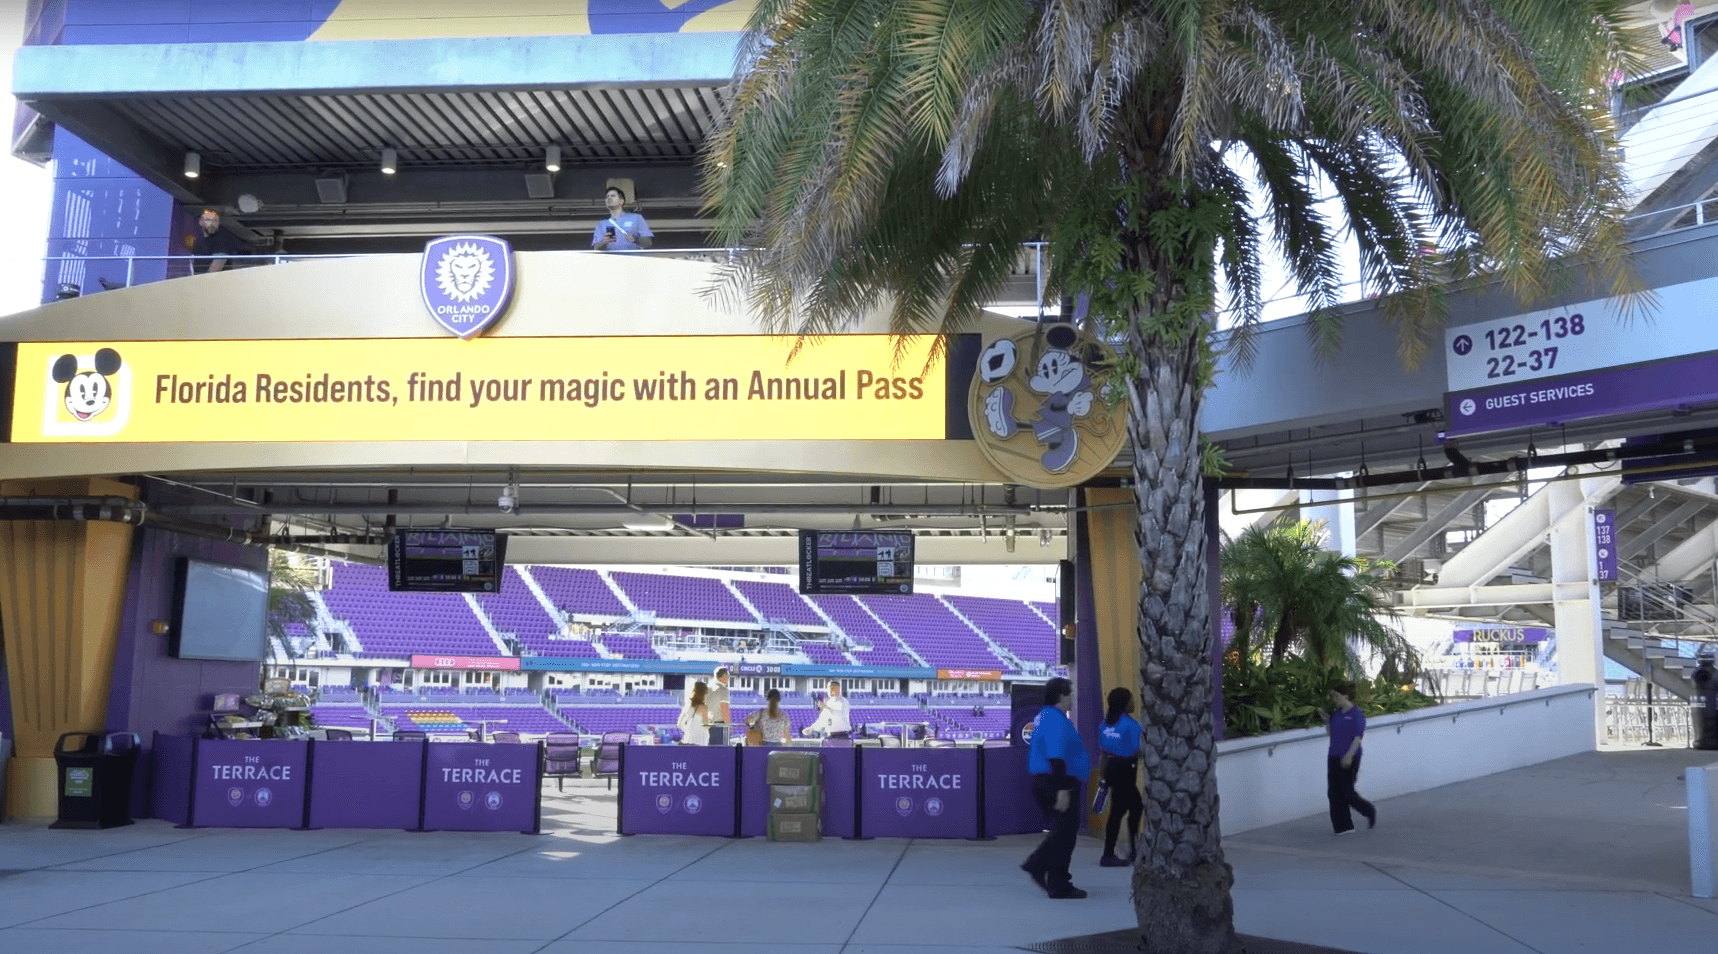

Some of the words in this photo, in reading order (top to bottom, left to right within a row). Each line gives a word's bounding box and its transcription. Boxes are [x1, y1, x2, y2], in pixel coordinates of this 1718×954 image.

[437, 305, 490, 315] ORLANDO
[451, 314, 475, 324] CITY
[1485, 314, 1585, 350] 122-138
[1486, 346, 1558, 379] 22-37
[155, 374, 247, 404] Florida
[255, 373, 398, 407] Residents,
[407, 371, 461, 402] find
[469, 378, 532, 408] your
[540, 371, 625, 408] magic
[633, 370, 696, 401] with
[704, 377, 738, 401] an
[747, 369, 846, 401] Annual
[856, 369, 924, 400] Pass
[1485, 393, 1526, 410] GUEST
[1530, 383, 1594, 404] SERVICES
[1597, 525, 1610, 535] 137
[1597, 534, 1611, 544] 138
[1599, 561, 1603, 570] 1
[1599, 570, 1609, 579] 37
[1473, 628, 1525, 642] RUCKUS
[212, 765, 291, 780] TERRACE
[911, 764, 927, 772] THE
[442, 768, 521, 783] TERRACE
[639, 772, 720, 787] TERRACE
[878, 774, 961, 789] TERRACE
